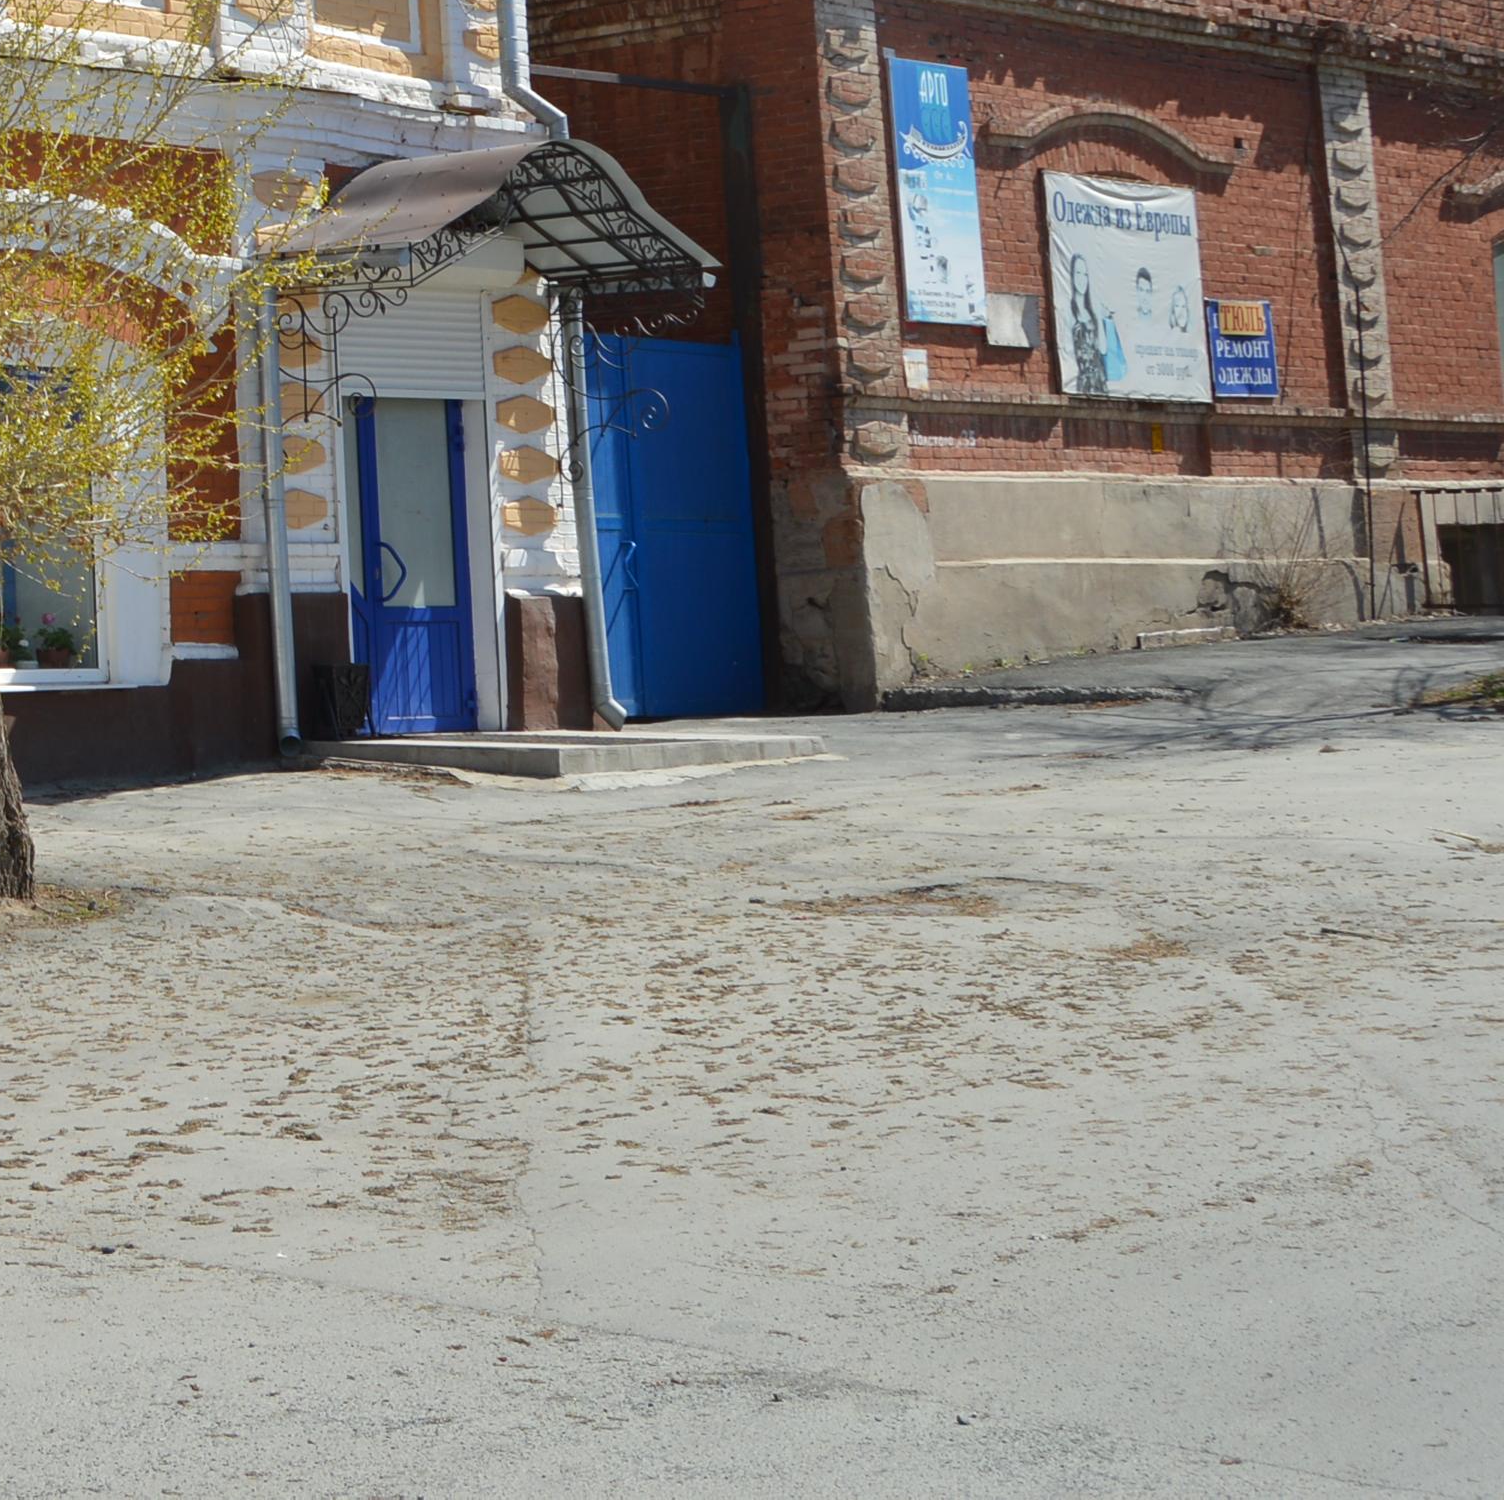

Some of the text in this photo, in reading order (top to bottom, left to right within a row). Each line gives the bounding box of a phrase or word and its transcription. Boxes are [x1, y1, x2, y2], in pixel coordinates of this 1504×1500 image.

[919, 69, 948, 107] АРГО
[1053, 191, 1191, 241] Одежда из Европы
[1221, 305, 1264, 332] ТЮЛЬ
[1215, 340, 1270, 358] РЕМОНТ
[1218, 367, 1272, 385] ОДЕЖДЫ
